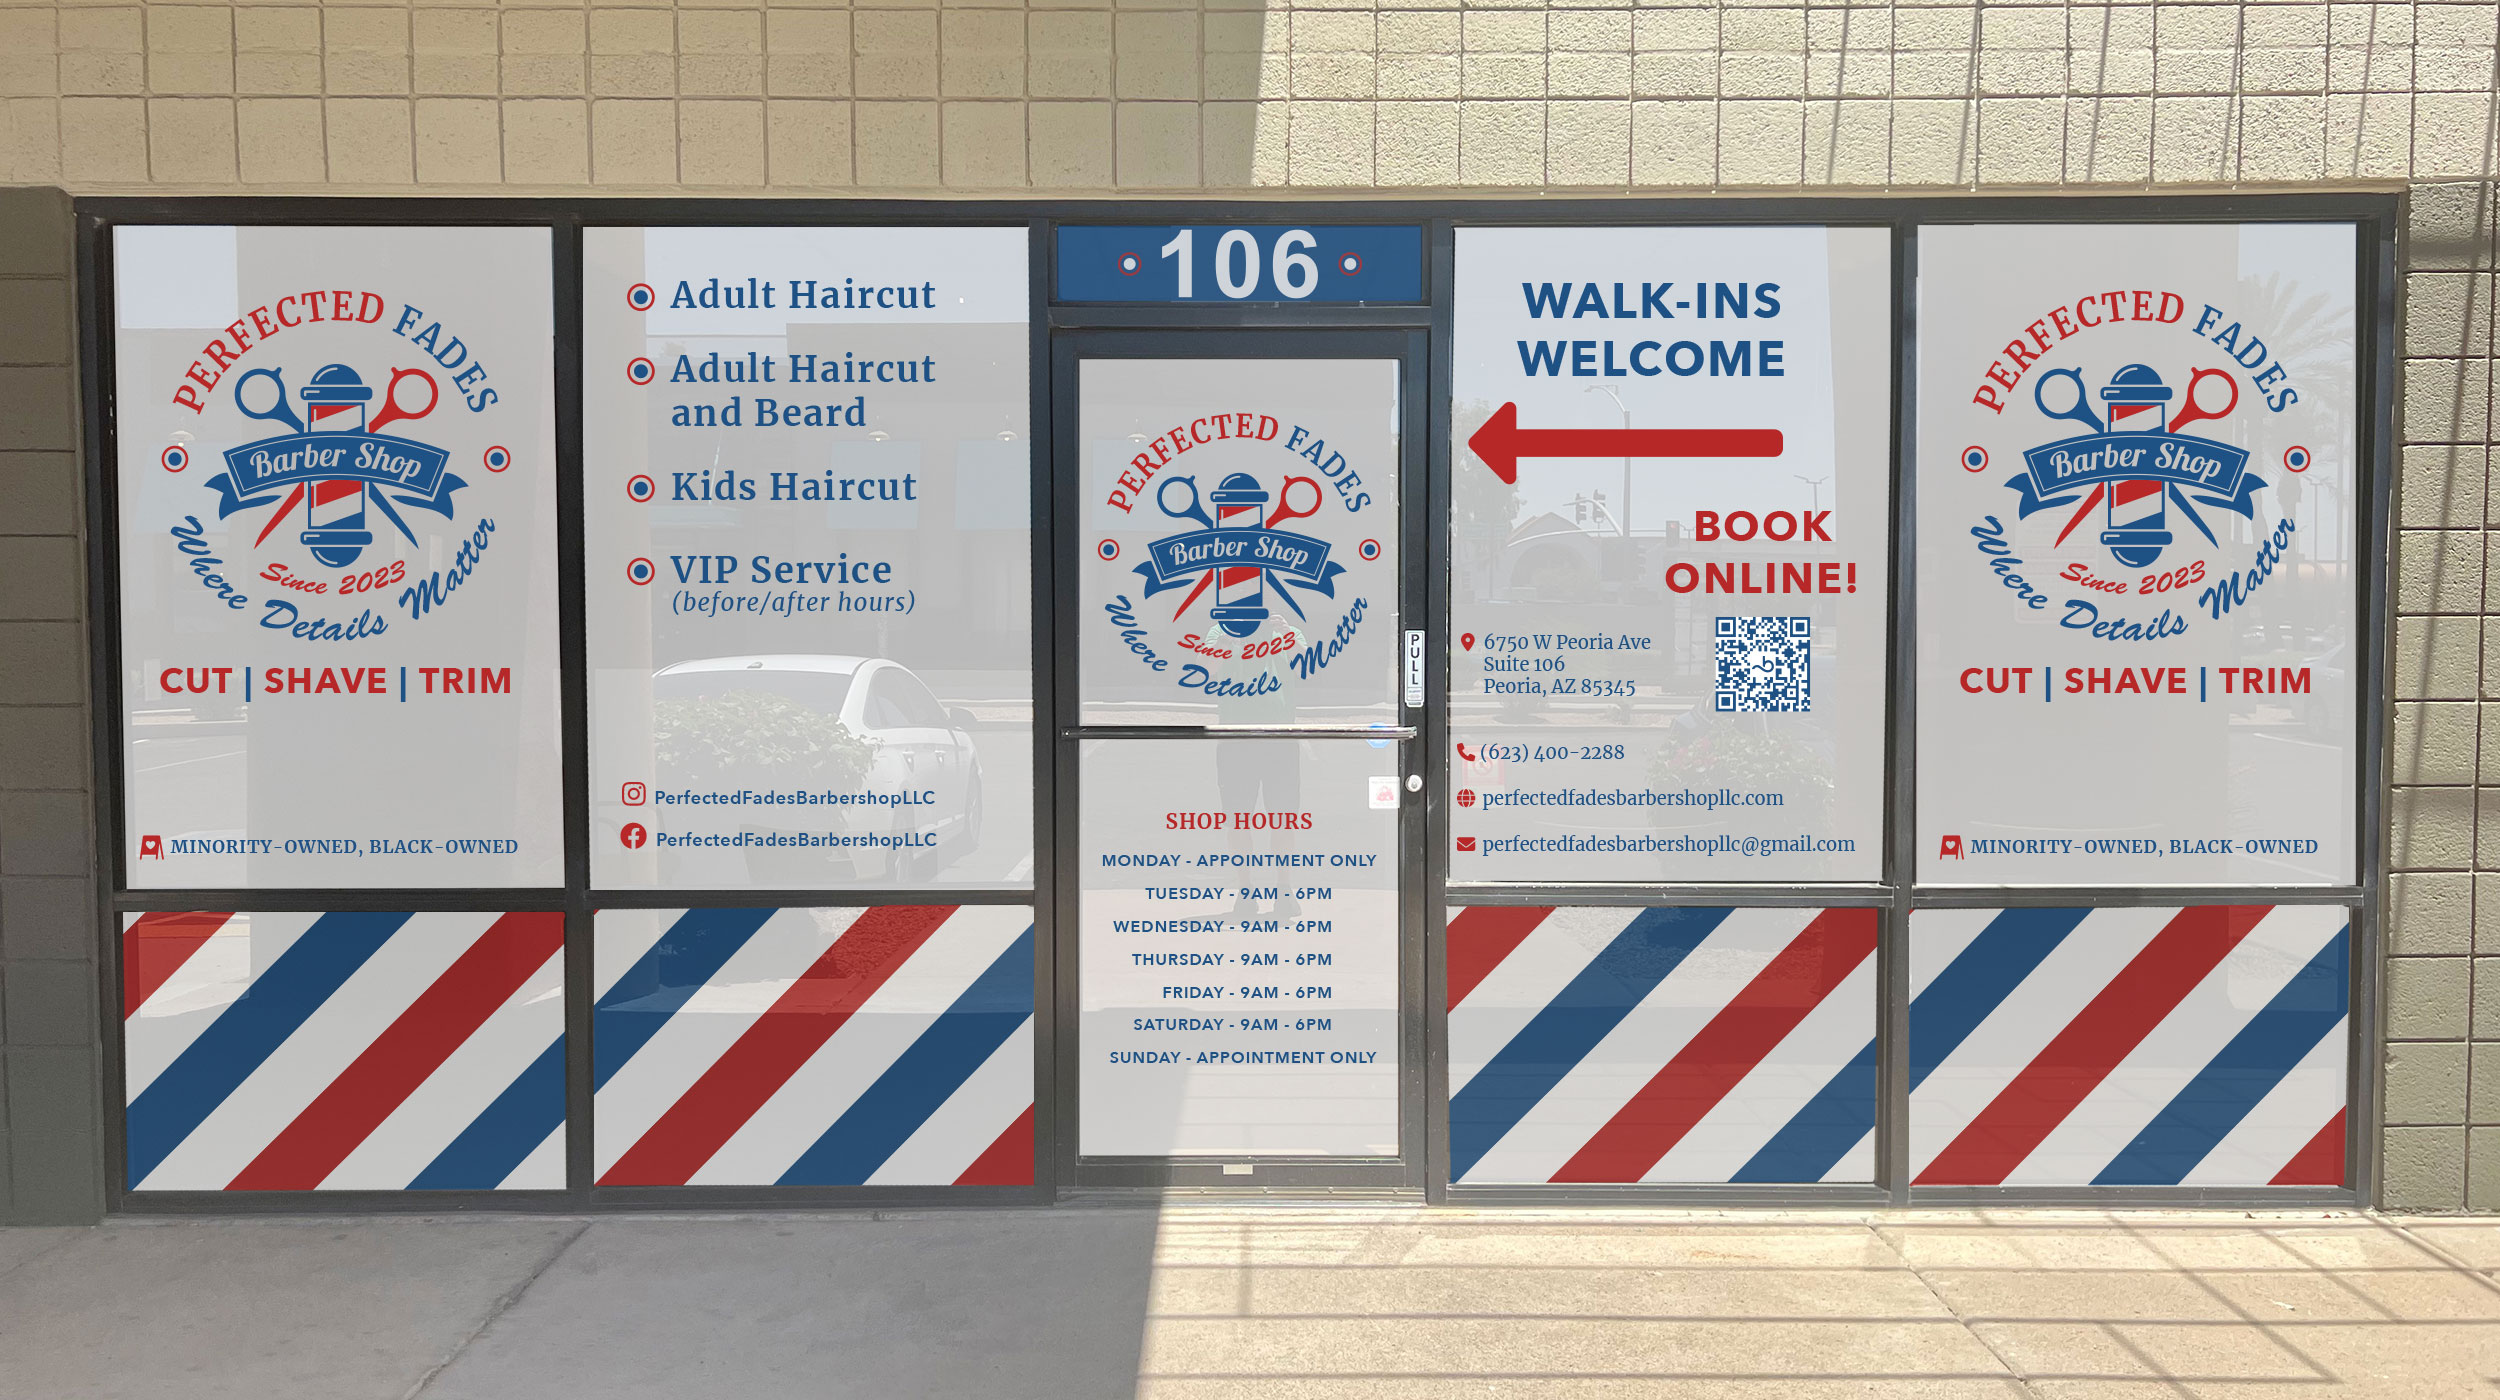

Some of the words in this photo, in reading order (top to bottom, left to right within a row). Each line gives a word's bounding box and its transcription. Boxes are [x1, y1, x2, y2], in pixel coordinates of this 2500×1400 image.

[1161, 229, 1319, 298] 106
[669, 278, 776, 308] Adult
[789, 278, 936, 308] Haircut
[1522, 282, 1780, 319] WALK-INS
[173, 291, 384, 415] PERFECTED
[393, 304, 498, 413] FADES
[670, 352, 775, 382] Adult
[789, 352, 935, 382] Haircut
[1517, 341, 1784, 376] WELCOME
[1973, 291, 2184, 415] PERFECTED
[2193, 304, 2298, 413] FADES
[672, 396, 742, 426] and
[755, 397, 865, 426] Beard
[250, 445, 346, 478] Barber
[354, 442, 421, 483] Shop
[1108, 413, 1279, 515] PERFECTED
[1285, 425, 1371, 513] FADES
[2050, 445, 2146, 478] Barber
[2154, 442, 2221, 483] Shop
[672, 470, 756, 500] Kids
[770, 470, 916, 500] Haircut
[1696, 511, 1832, 541] BOOK
[1169, 537, 1247, 565] Barber
[1254, 536, 1309, 569] Shop
[171, 516, 248, 609] Where
[260, 599, 388, 641] Details
[399, 518, 496, 620] Matter
[259, 563, 328, 594] Since
[339, 560, 405, 595] 2023
[670, 556, 737, 583] VIP
[752, 553, 891, 584] Service
[1666, 563, 1856, 593] ONLINE!
[1971, 516, 2048, 609] Where
[2060, 599, 2188, 641] Details
[2199, 518, 2296, 620] Matter
[2059, 563, 2128, 594] Since
[2139, 560, 2205, 595] 2023
[673, 591, 830, 617] (before/after
[839, 591, 914, 614] hours)
[1105, 595, 1167, 671] Where
[1178, 664, 1282, 697] Details
[1290, 597, 1369, 679] Matter
[1177, 633, 1233, 659] Since
[1241, 631, 1296, 660] 2023
[1485, 634, 1528, 652] 6750
[1534, 635, 1552, 648] W
[1557, 633, 1613, 649] Peoria
[1618, 635, 1650, 649] Ave
[1411, 634, 1420, 685] PULL
[1484, 656, 1528, 671] Suite
[1536, 656, 1564, 671] 106
[160, 668, 232, 693] CUT
[265, 668, 386, 693] SHAVE
[419, 668, 510, 693] TRIM
[1485, 677, 1546, 696] Peoria,
[1552, 679, 1576, 693] AZ
[1582, 679, 1634, 696] 85345
[1960, 668, 2032, 693] CUT
[2064, 668, 2186, 694] SHAVE
[2219, 668, 2310, 693] TRIM
[1481, 744, 1528, 762] (623)
[1535, 745, 1624, 762] 400-2288
[656, 790, 935, 808] PerfectedFadesBarbershopLLC
[1483, 789, 1784, 810] perfectedfadesbarbershopllc.com
[1167, 813, 1226, 829] SHOP
[1234, 813, 1312, 829] HOURS
[171, 840, 362, 856] MINORITY-OWNED,
[370, 840, 517, 853] BLACK-OWNED
[657, 832, 936, 850] PerfectedFadesBarbershopLLC
[1484, 835, 1855, 856] perfectedfadesbarbershopllc@gmail.com
[1971, 840, 2162, 856] MINORITY-OWNED,
[2170, 840, 2317, 853] BLACK-OWNED
[1103, 855, 1180, 866] MONDAY
[1197, 854, 1324, 866] APPOINTMENT
[1331, 855, 1376, 866] ONLY
[1145, 888, 1223, 899] TUESDAY
[1241, 888, 1277, 899] 9AM
[1296, 888, 1331, 899] 6PM
[1114, 921, 1223, 932] WEDNESDAY
[1241, 921, 1278, 932] 9AM
[1296, 921, 1331, 932] 6PM
[1132, 954, 1223, 965] THURSDAY
[1241, 954, 1278, 965] 9AM
[1296, 954, 1331, 965] 6PM
[1164, 987, 1223, 998] FRIDAY
[1241, 987, 1277, 998] 9AM
[1296, 987, 1331, 998] 6PM
[1134, 1019, 1223, 1030] SATURDAY
[1241, 1018, 1277, 1030] 9AM
[1296, 1018, 1331, 1030] 6PM
[1110, 1052, 1180, 1064] SUNDAY
[1197, 1052, 1325, 1064] APPOINTMENT
[1331, 1052, 1376, 1064] ONLY
